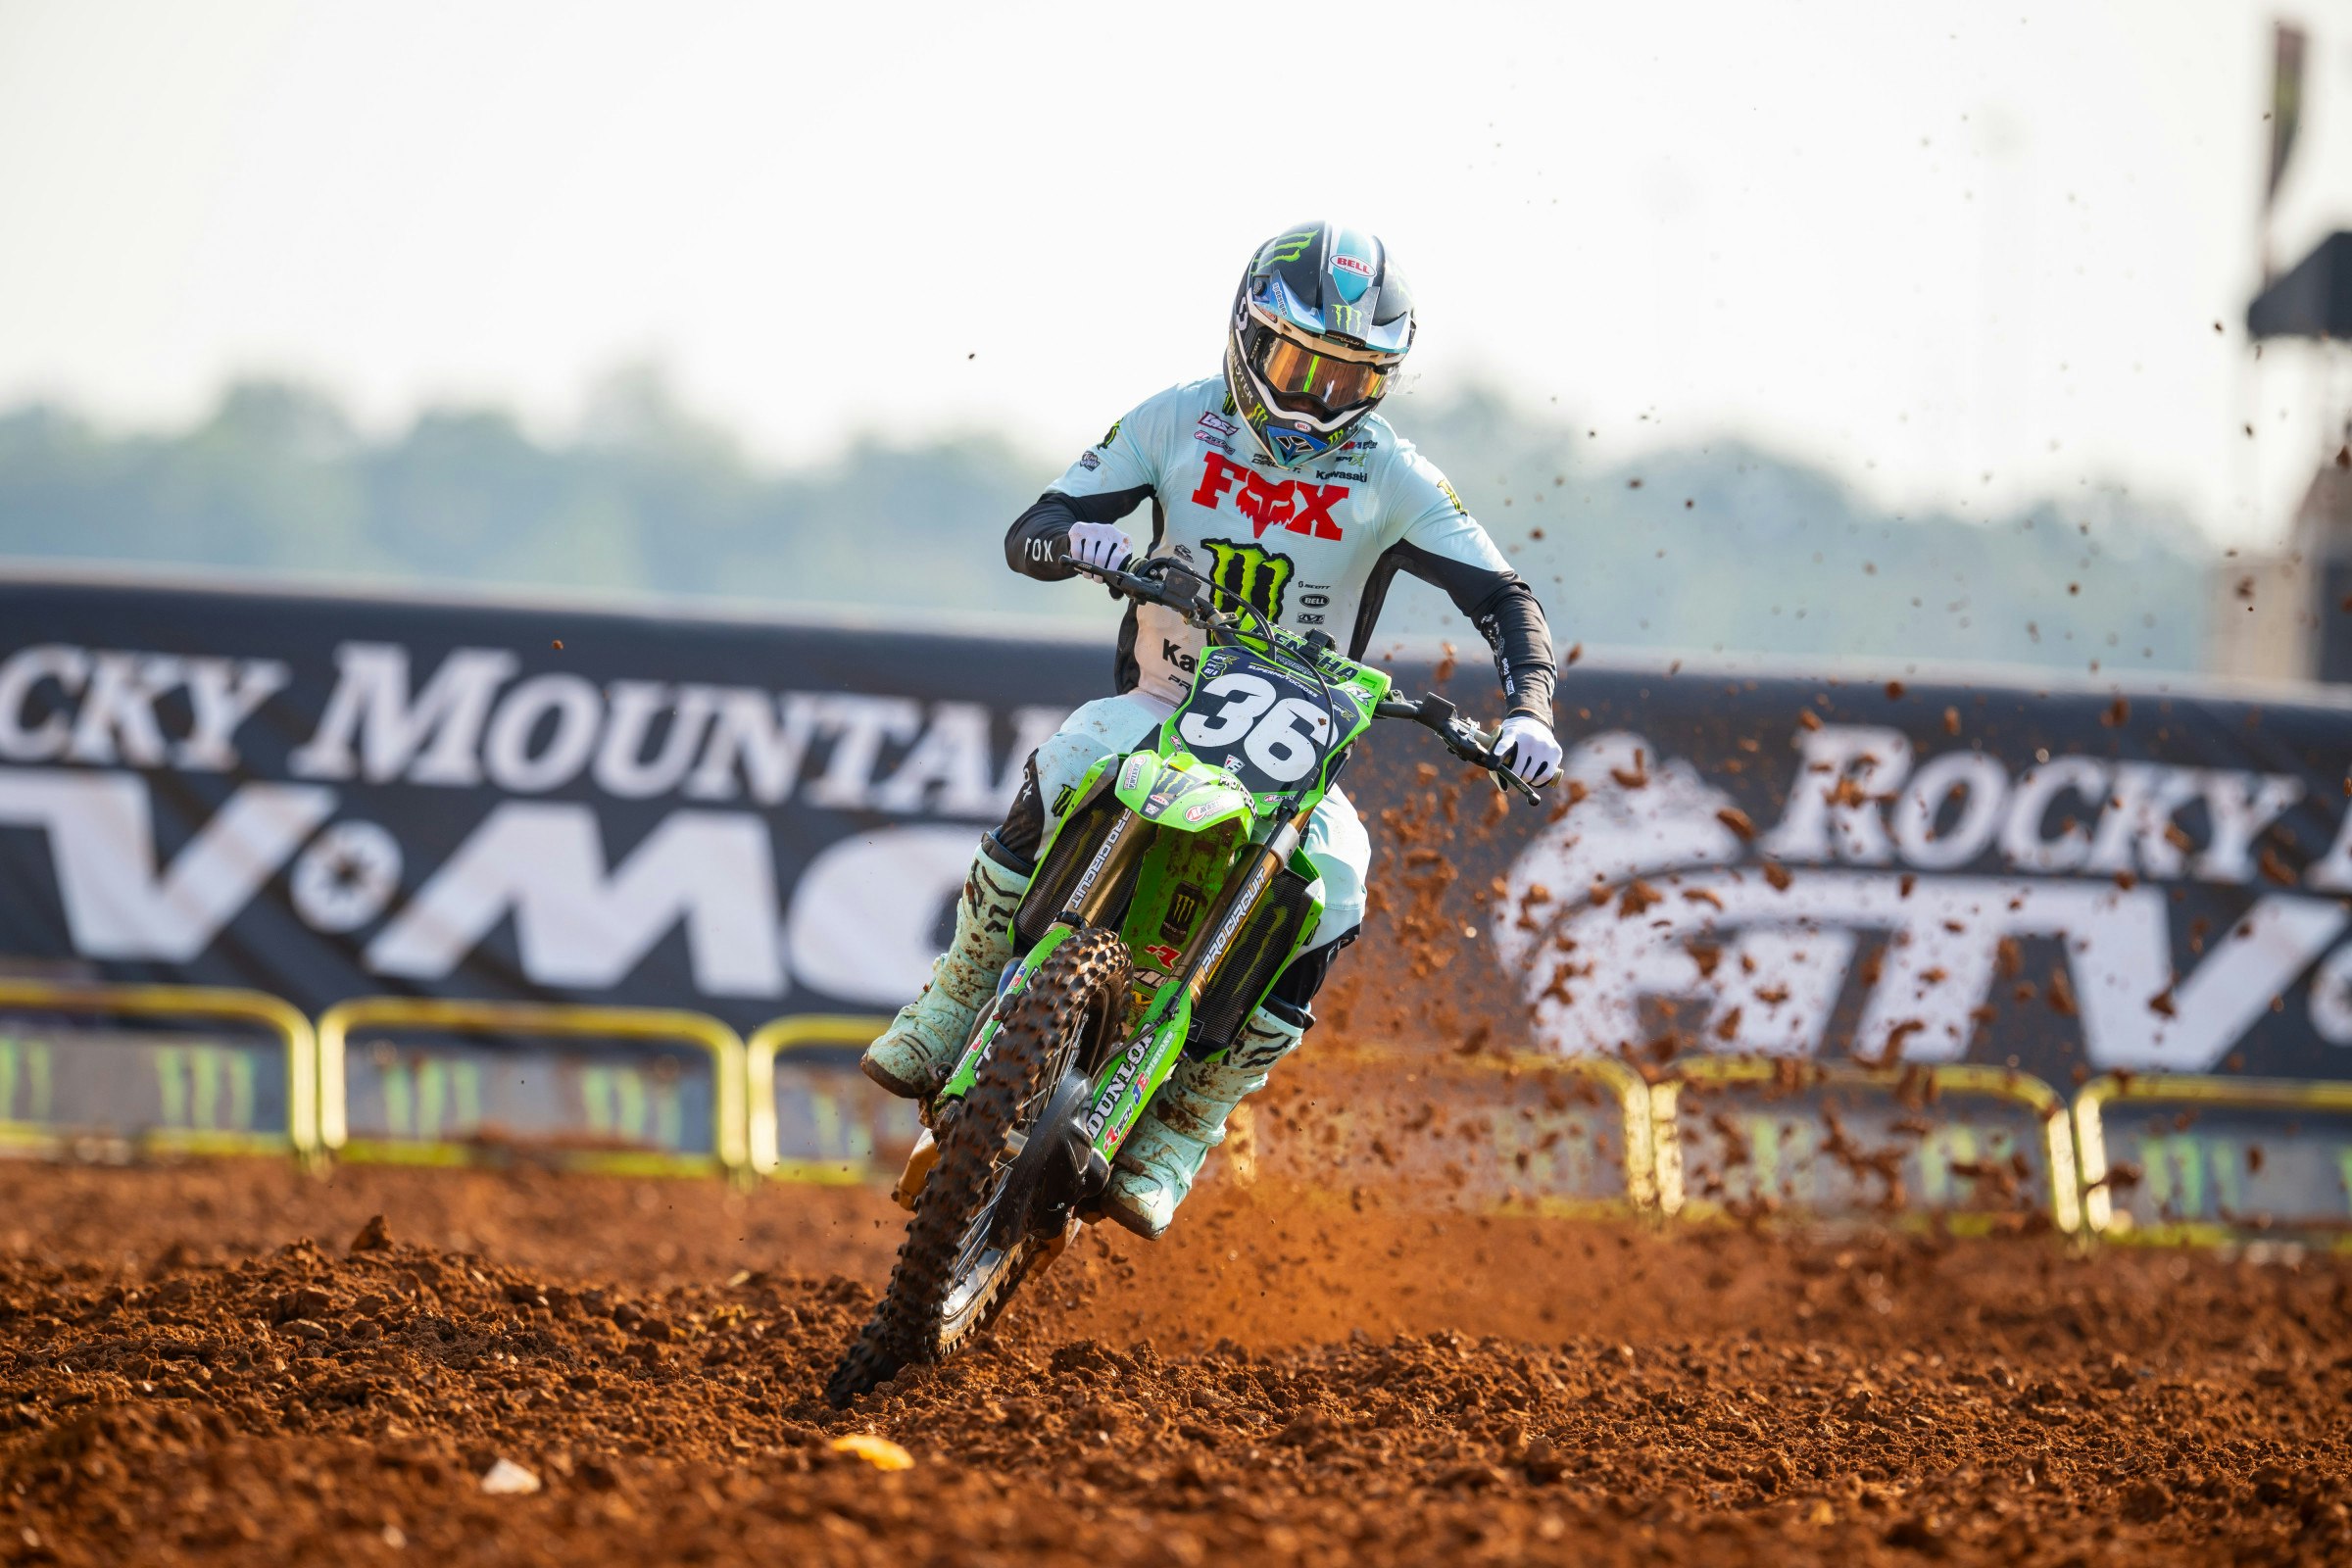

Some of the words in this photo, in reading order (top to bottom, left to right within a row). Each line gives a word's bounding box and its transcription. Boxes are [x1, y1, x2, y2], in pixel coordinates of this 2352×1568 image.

[1337, 257, 1370, 274] BELL
[1192, 451, 1349, 541] FOX
[1316, 470, 1368, 482] Kawasaki
[1212, 654, 1240, 664] SMX
[1248, 664, 1318, 698] SUPERMOTOCROSS
[1179, 672, 1339, 782] 36
[1760, 723, 2306, 884] ROCKY
[1070, 843, 1112, 909] CIRCUIT
[1200, 930, 1228, 974] PRO
[1224, 867, 1265, 938] CIRCUIT
[1087, 1023, 1155, 1140] DUNLOP
